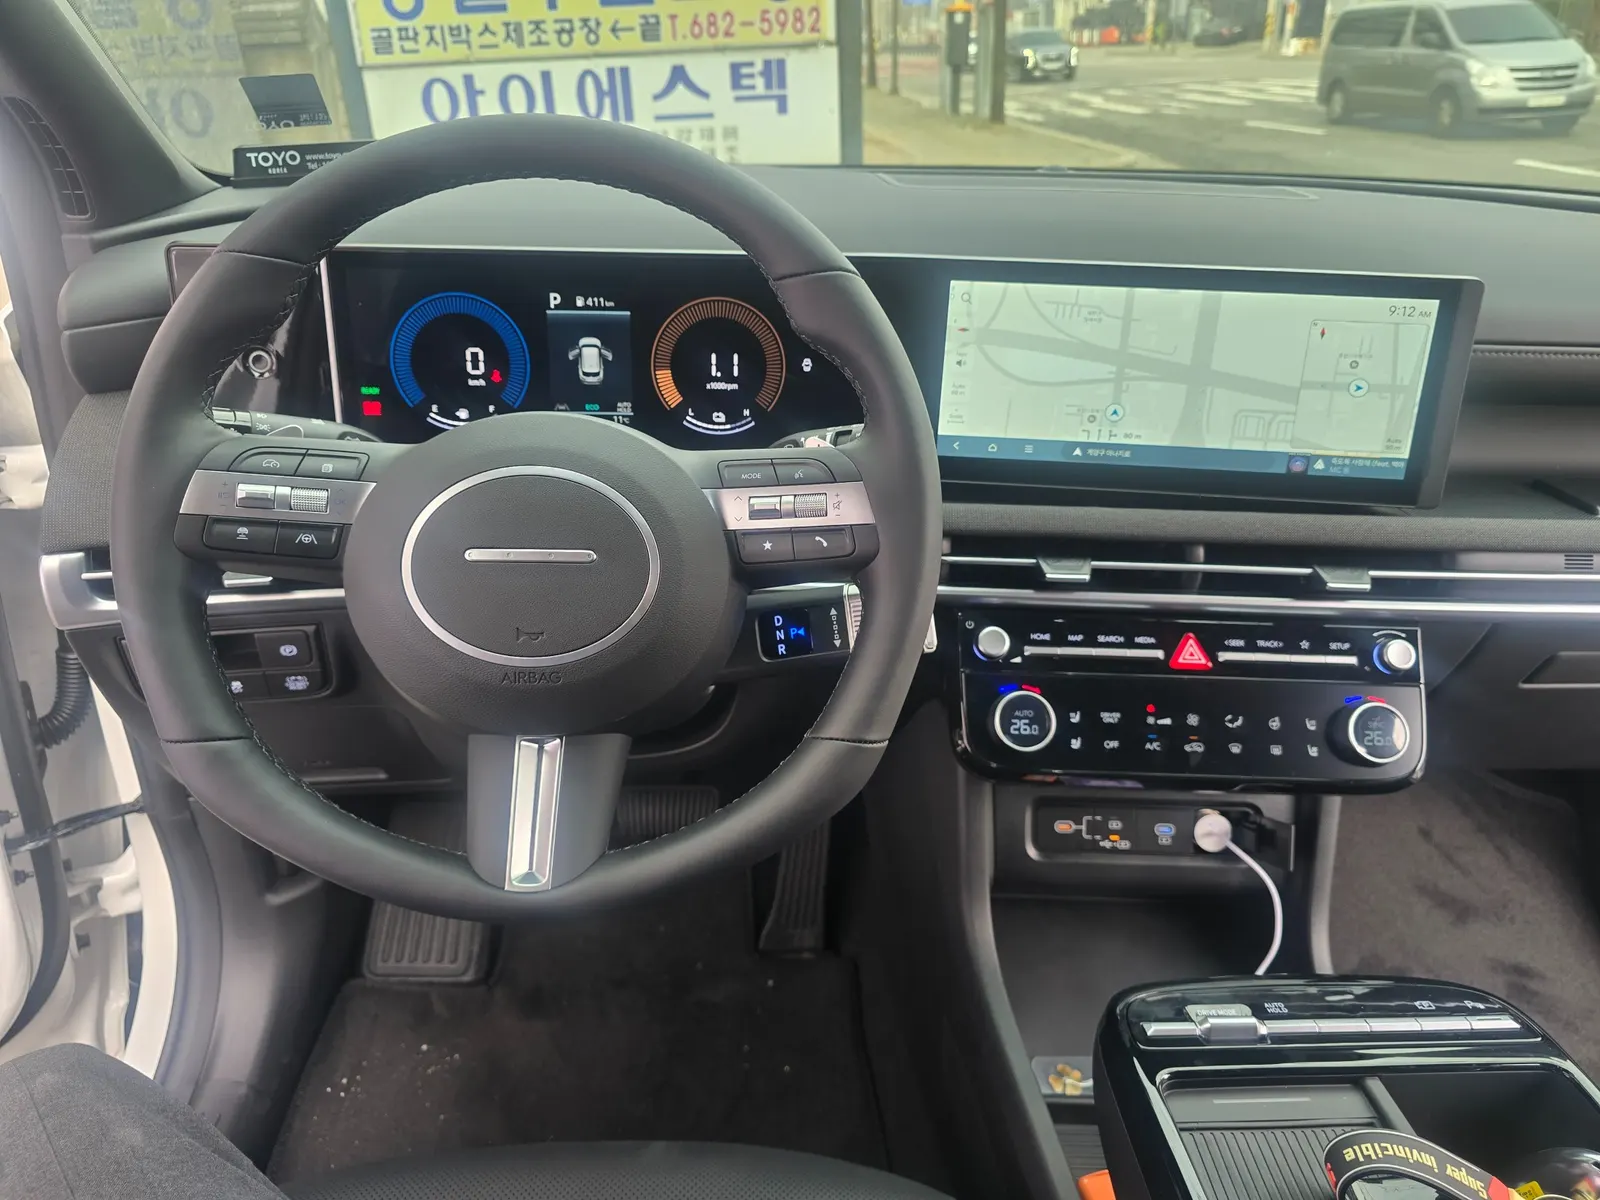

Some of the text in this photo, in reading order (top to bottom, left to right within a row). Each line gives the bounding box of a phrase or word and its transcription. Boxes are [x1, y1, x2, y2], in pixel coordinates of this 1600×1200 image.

[370, 17, 602, 55] 골판지박스제조공장
[667, 6, 821, 41] T.682-5982
[421, 58, 788, 124] 아이에스텍
[246, 150, 300, 168] TOYO
[549, 292, 562, 309] P
[1389, 305, 1416, 318] 9:12
[465, 347, 486, 375] 0
[711, 352, 739, 377] 1.1
[585, 403, 600, 411] ECO
[743, 408, 750, 416] H
[741, 472, 762, 480] MODE
[774, 615, 783, 627] D
[776, 628, 798, 640] N P
[1030, 633, 1157, 644] HOME MAP SEARCH MEDIA
[778, 644, 787, 656] R
[1329, 642, 1351, 650] SETUP
[501, 671, 563, 685] AIRBAG
[1014, 709, 1034, 717] AUTO
[1010, 719, 1040, 736] 26.0
[1104, 740, 1119, 749] OFF
[1145, 741, 1162, 751] A/C
[1343, 1142, 1438, 1174] invincible
